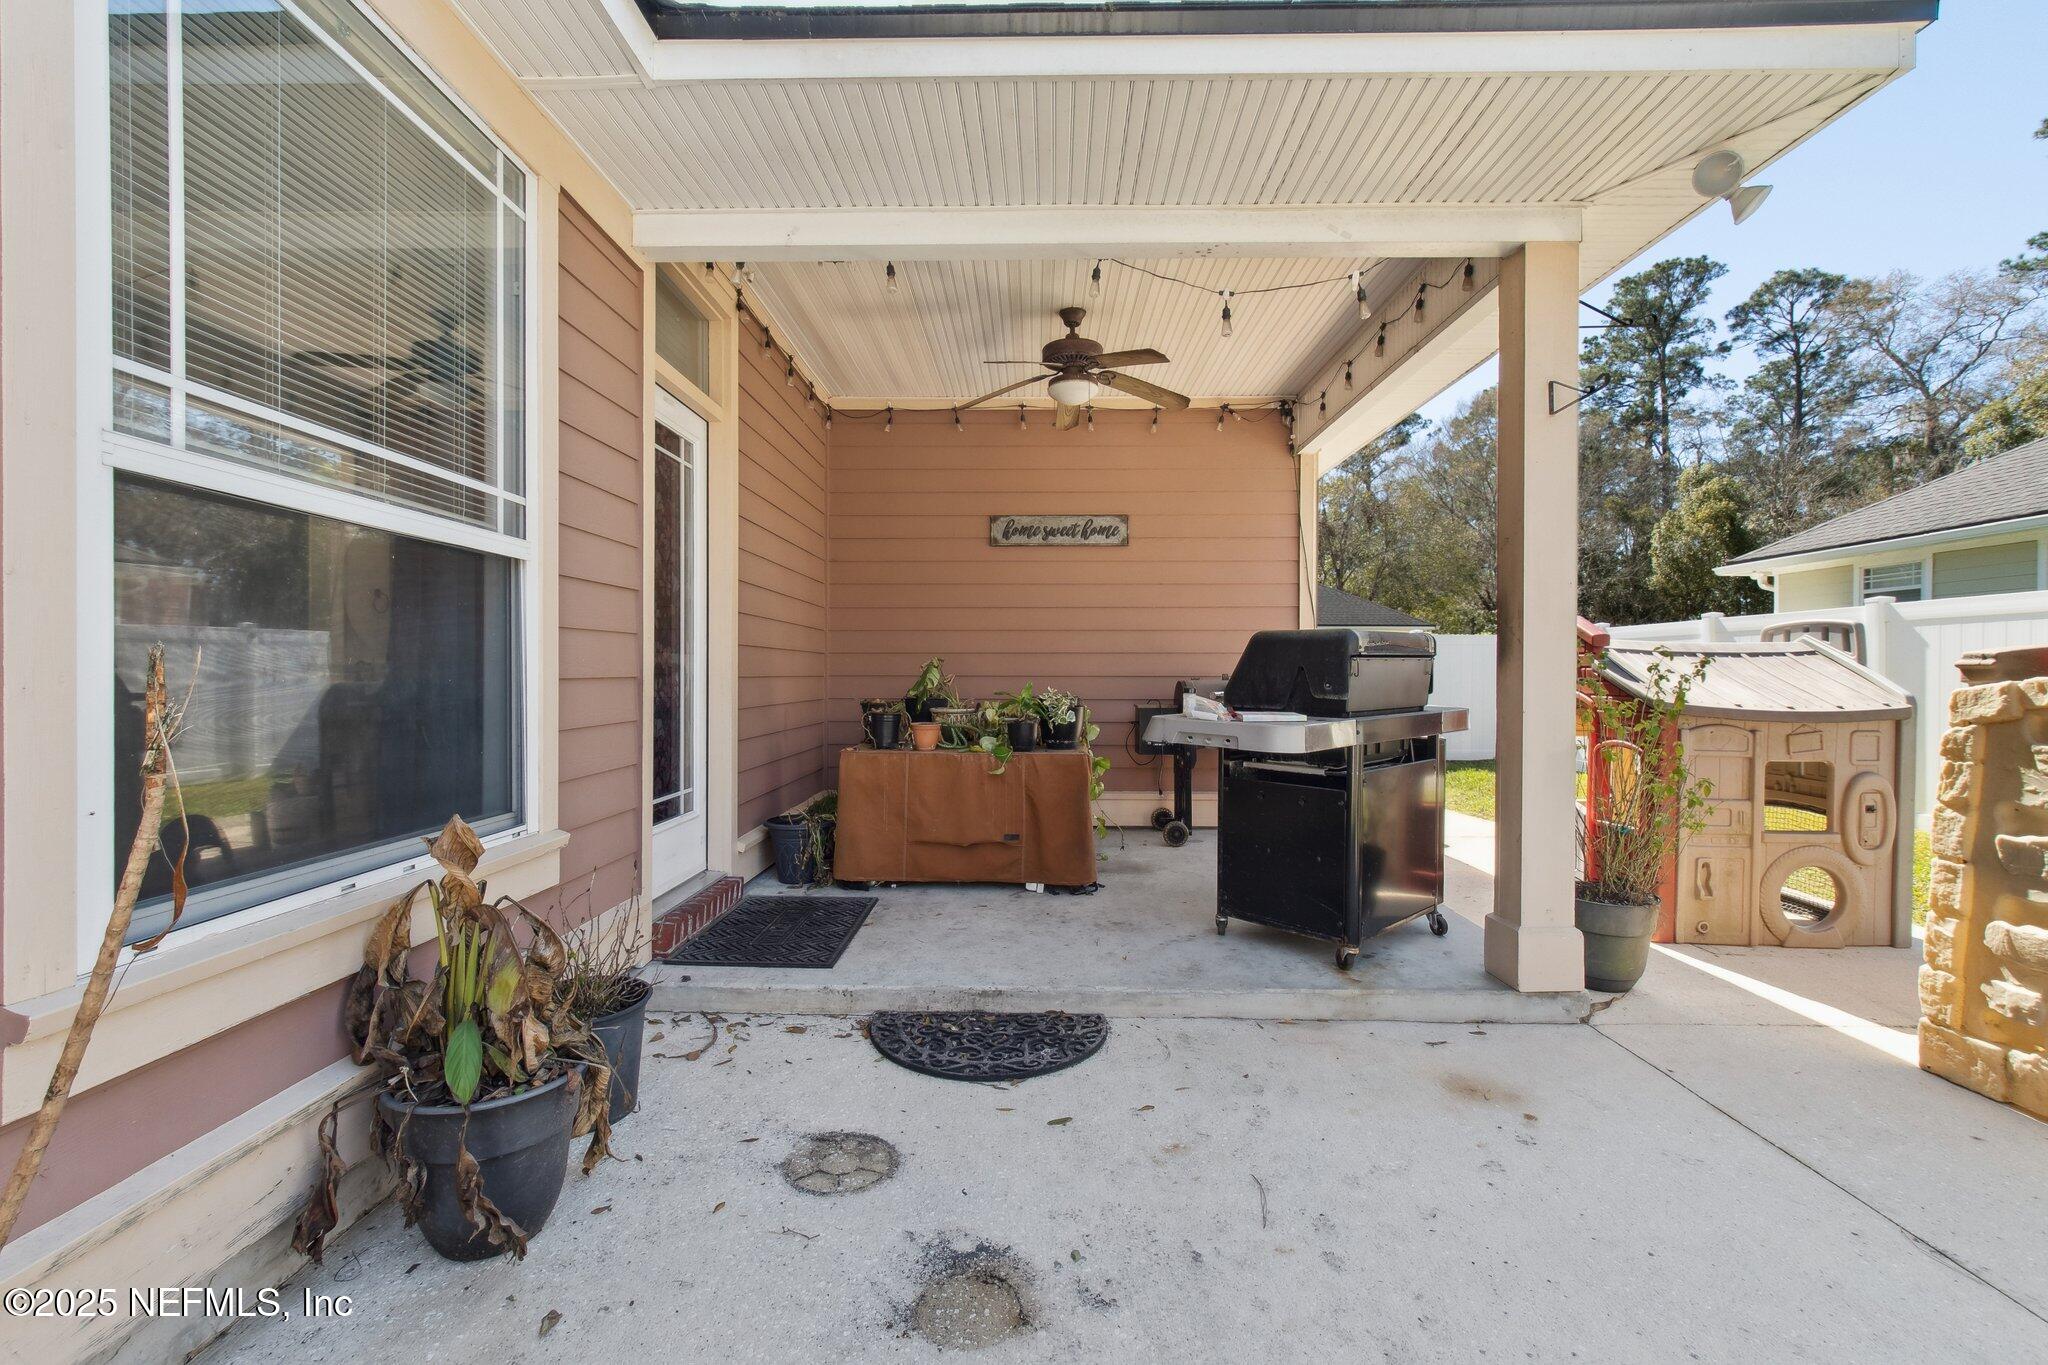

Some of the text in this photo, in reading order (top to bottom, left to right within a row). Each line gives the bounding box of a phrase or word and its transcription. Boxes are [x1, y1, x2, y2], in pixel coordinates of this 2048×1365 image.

[1002, 518, 1120, 541] home sweet home
